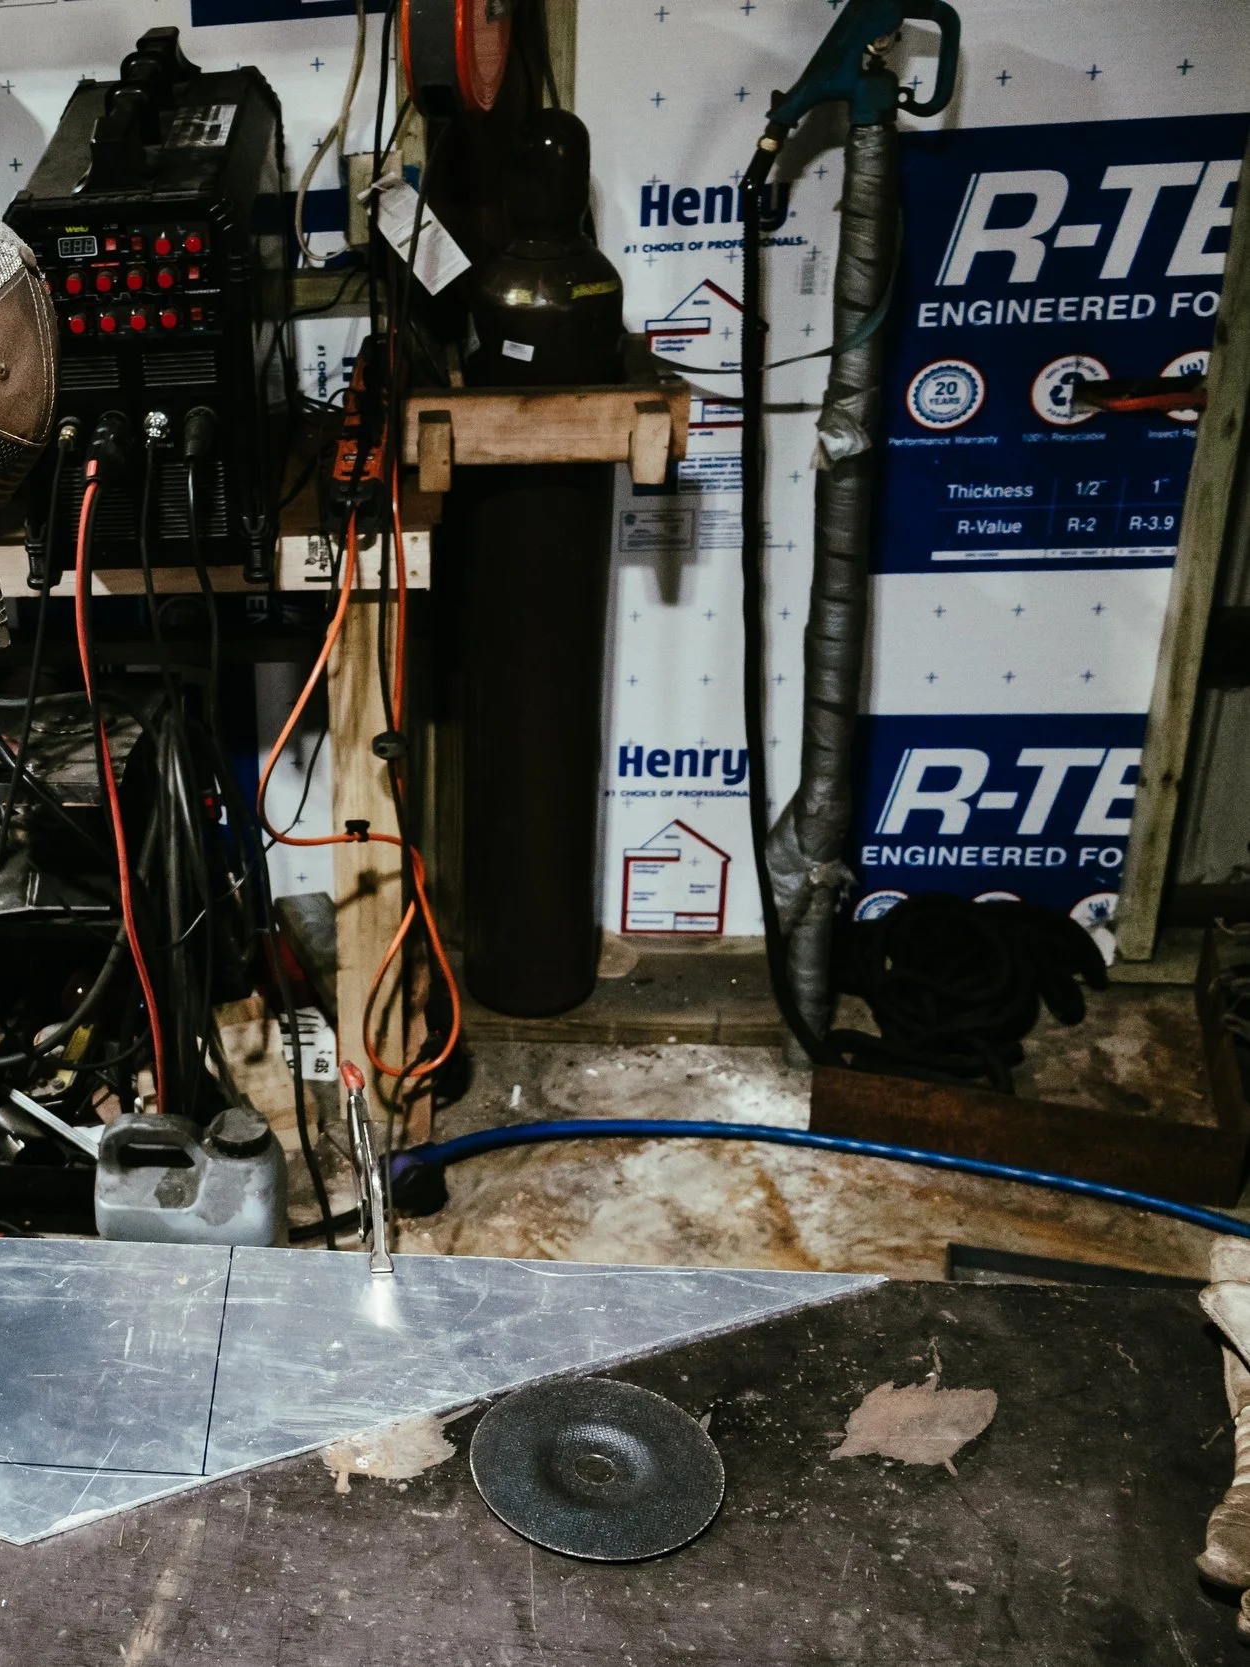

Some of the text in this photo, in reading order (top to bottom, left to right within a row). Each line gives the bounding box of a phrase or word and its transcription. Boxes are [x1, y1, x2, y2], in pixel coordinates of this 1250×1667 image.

[642, 242, 684, 253] CHOICE
[688, 241, 704, 250] OF
[707, 236, 804, 249] PROFEONALS
[916, 293, 1156, 328] ENGINEERED
[935, 381, 958, 396] 20
[947, 483, 1034, 499] Thickness
[957, 515, 1175, 535] R-Value R-2 R-3.9
[618, 745, 750, 786] Henry
[860, 845, 1067, 868] ENGINEERED
